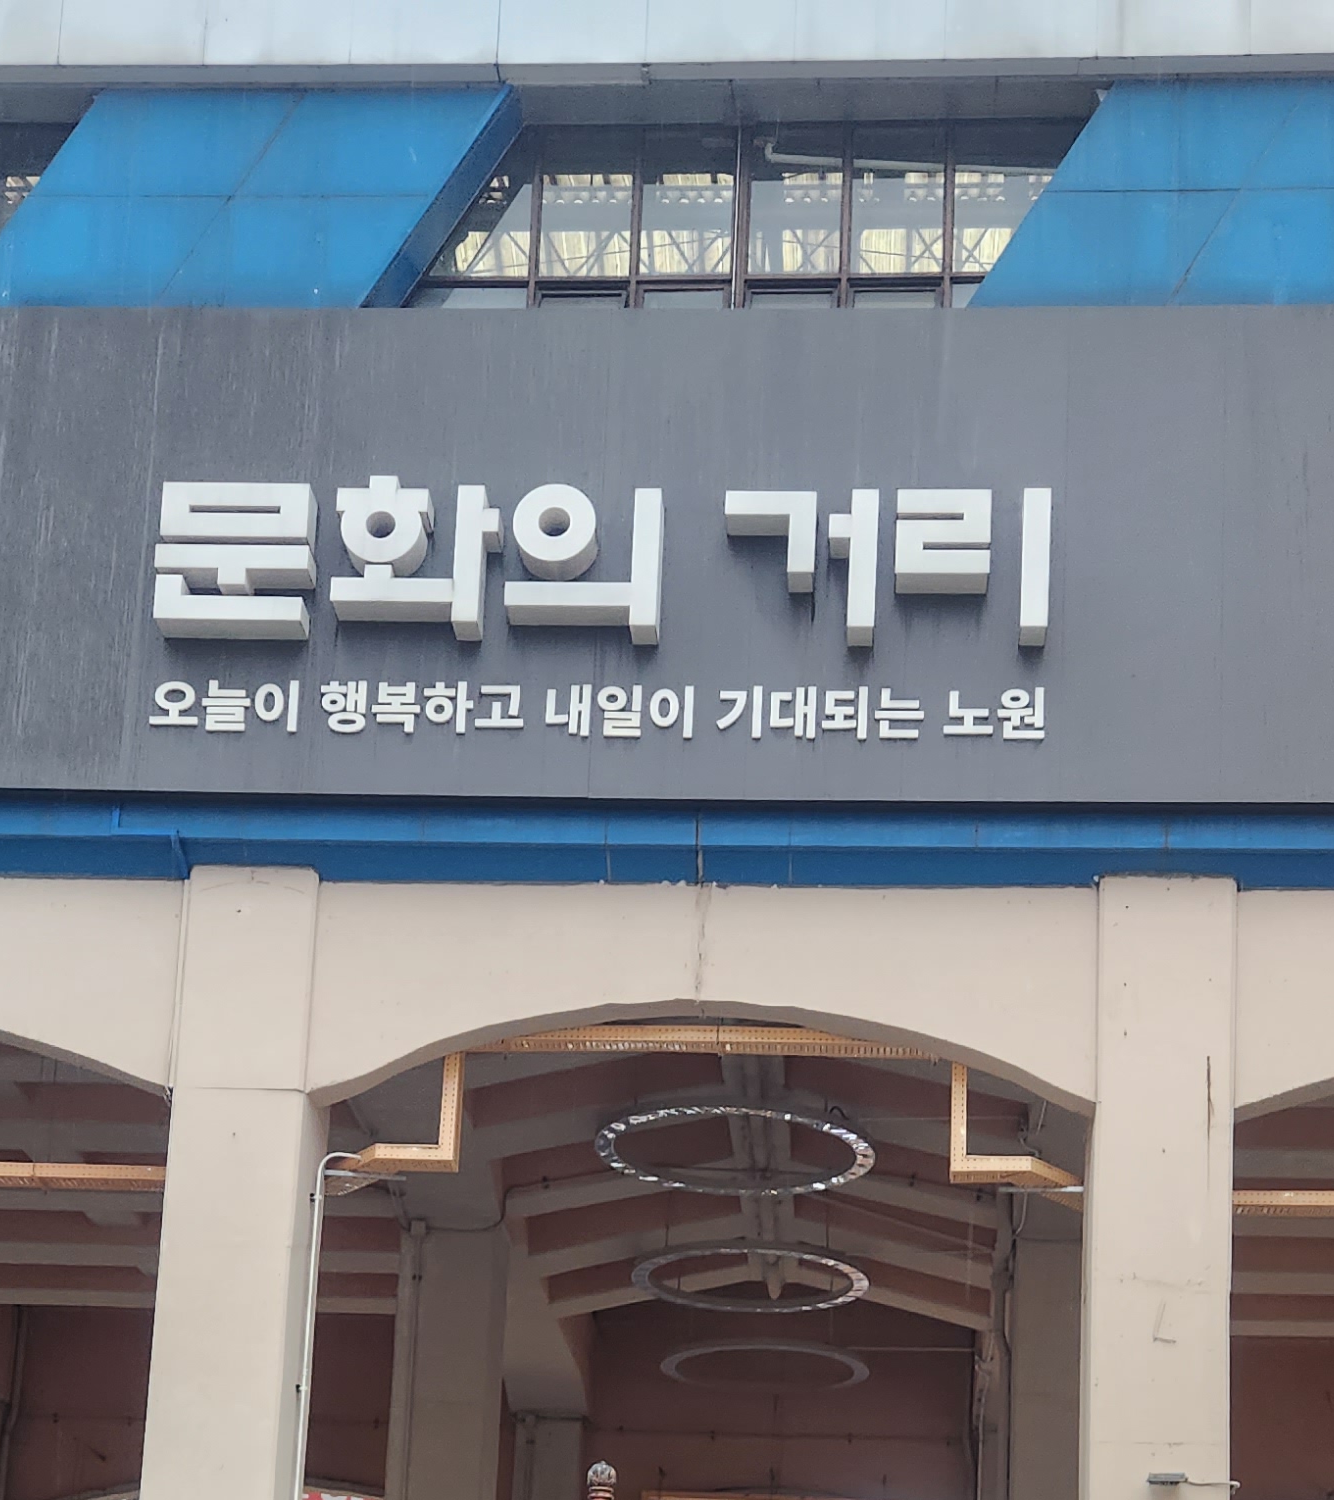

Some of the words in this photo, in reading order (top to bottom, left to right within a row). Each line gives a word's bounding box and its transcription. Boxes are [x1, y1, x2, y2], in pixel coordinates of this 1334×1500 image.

[153, 475, 664, 646] 문화의
[723, 486, 1053, 648] 거리
[148, 679, 302, 734] 오늘이
[320, 681, 525, 735] 행복하고
[544, 683, 695, 738] 내일이
[715, 685, 926, 740] 기대되는
[943, 687, 1048, 741] 노원
